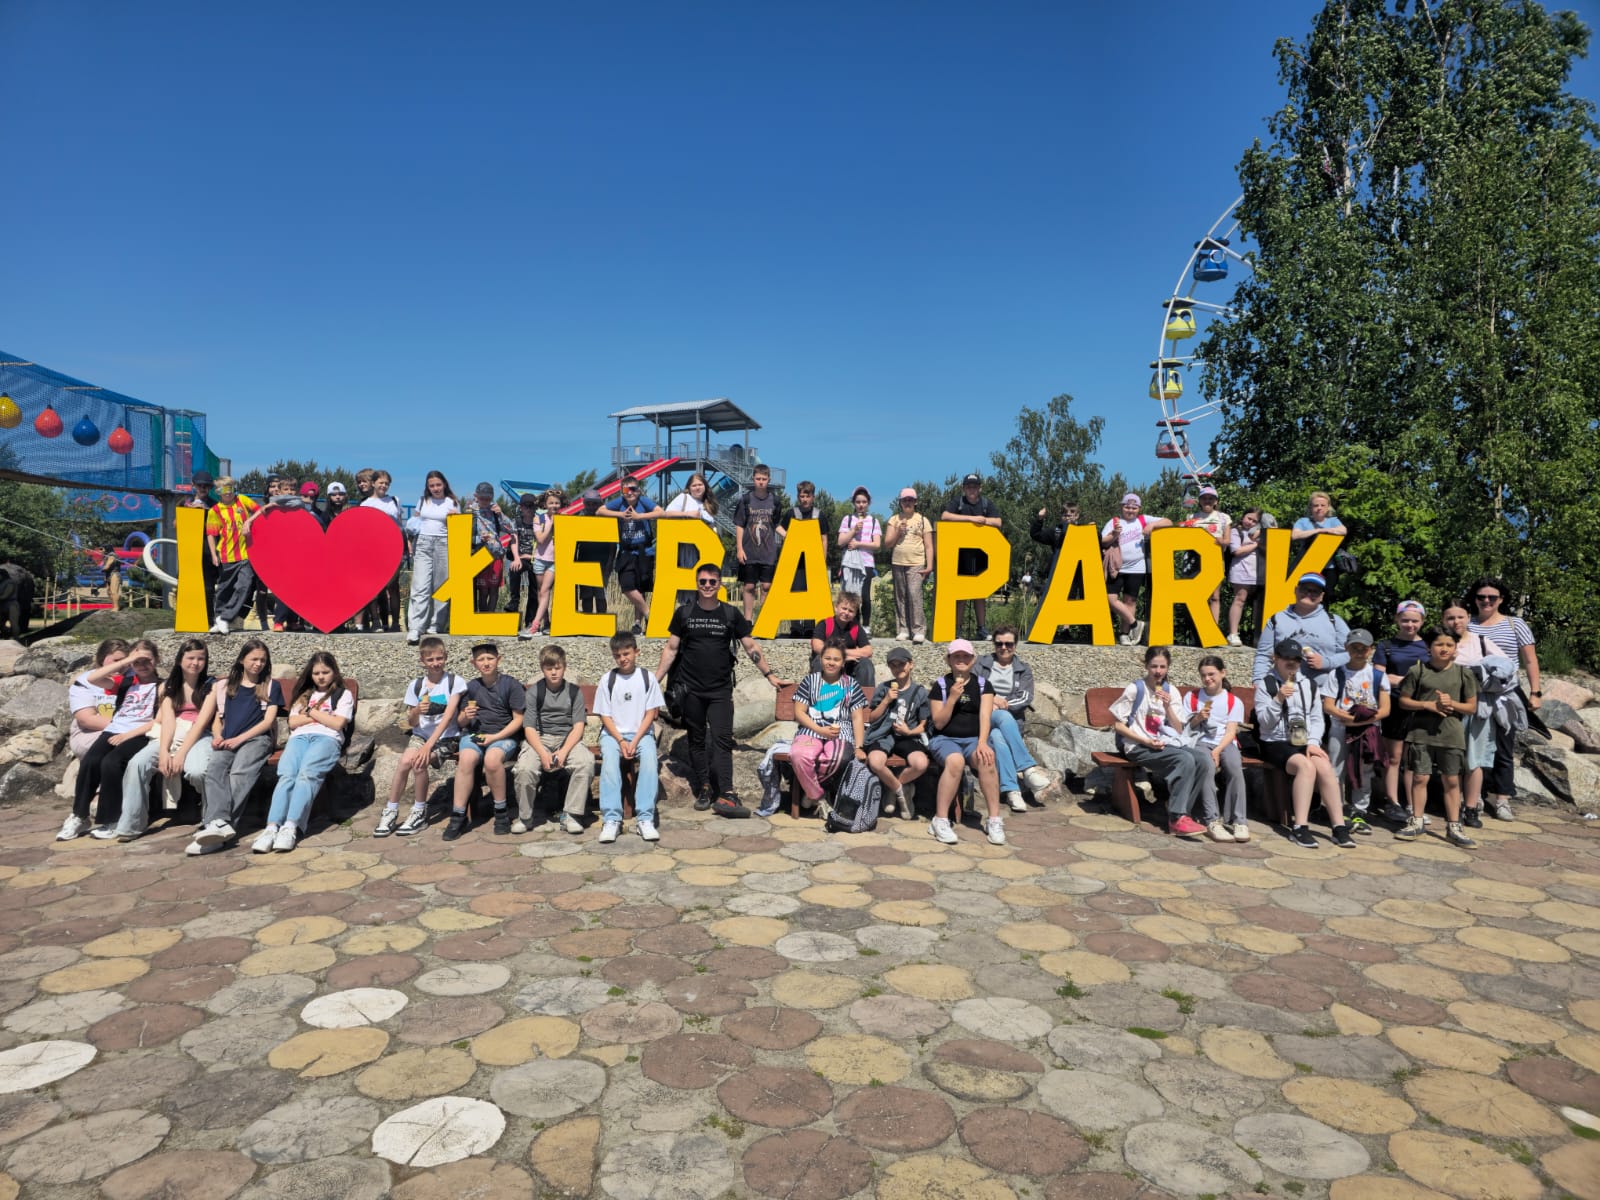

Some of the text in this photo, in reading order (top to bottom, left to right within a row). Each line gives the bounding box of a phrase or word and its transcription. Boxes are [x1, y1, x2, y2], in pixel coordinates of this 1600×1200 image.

[174, 507, 1345, 648] I ŁEBA PARK
